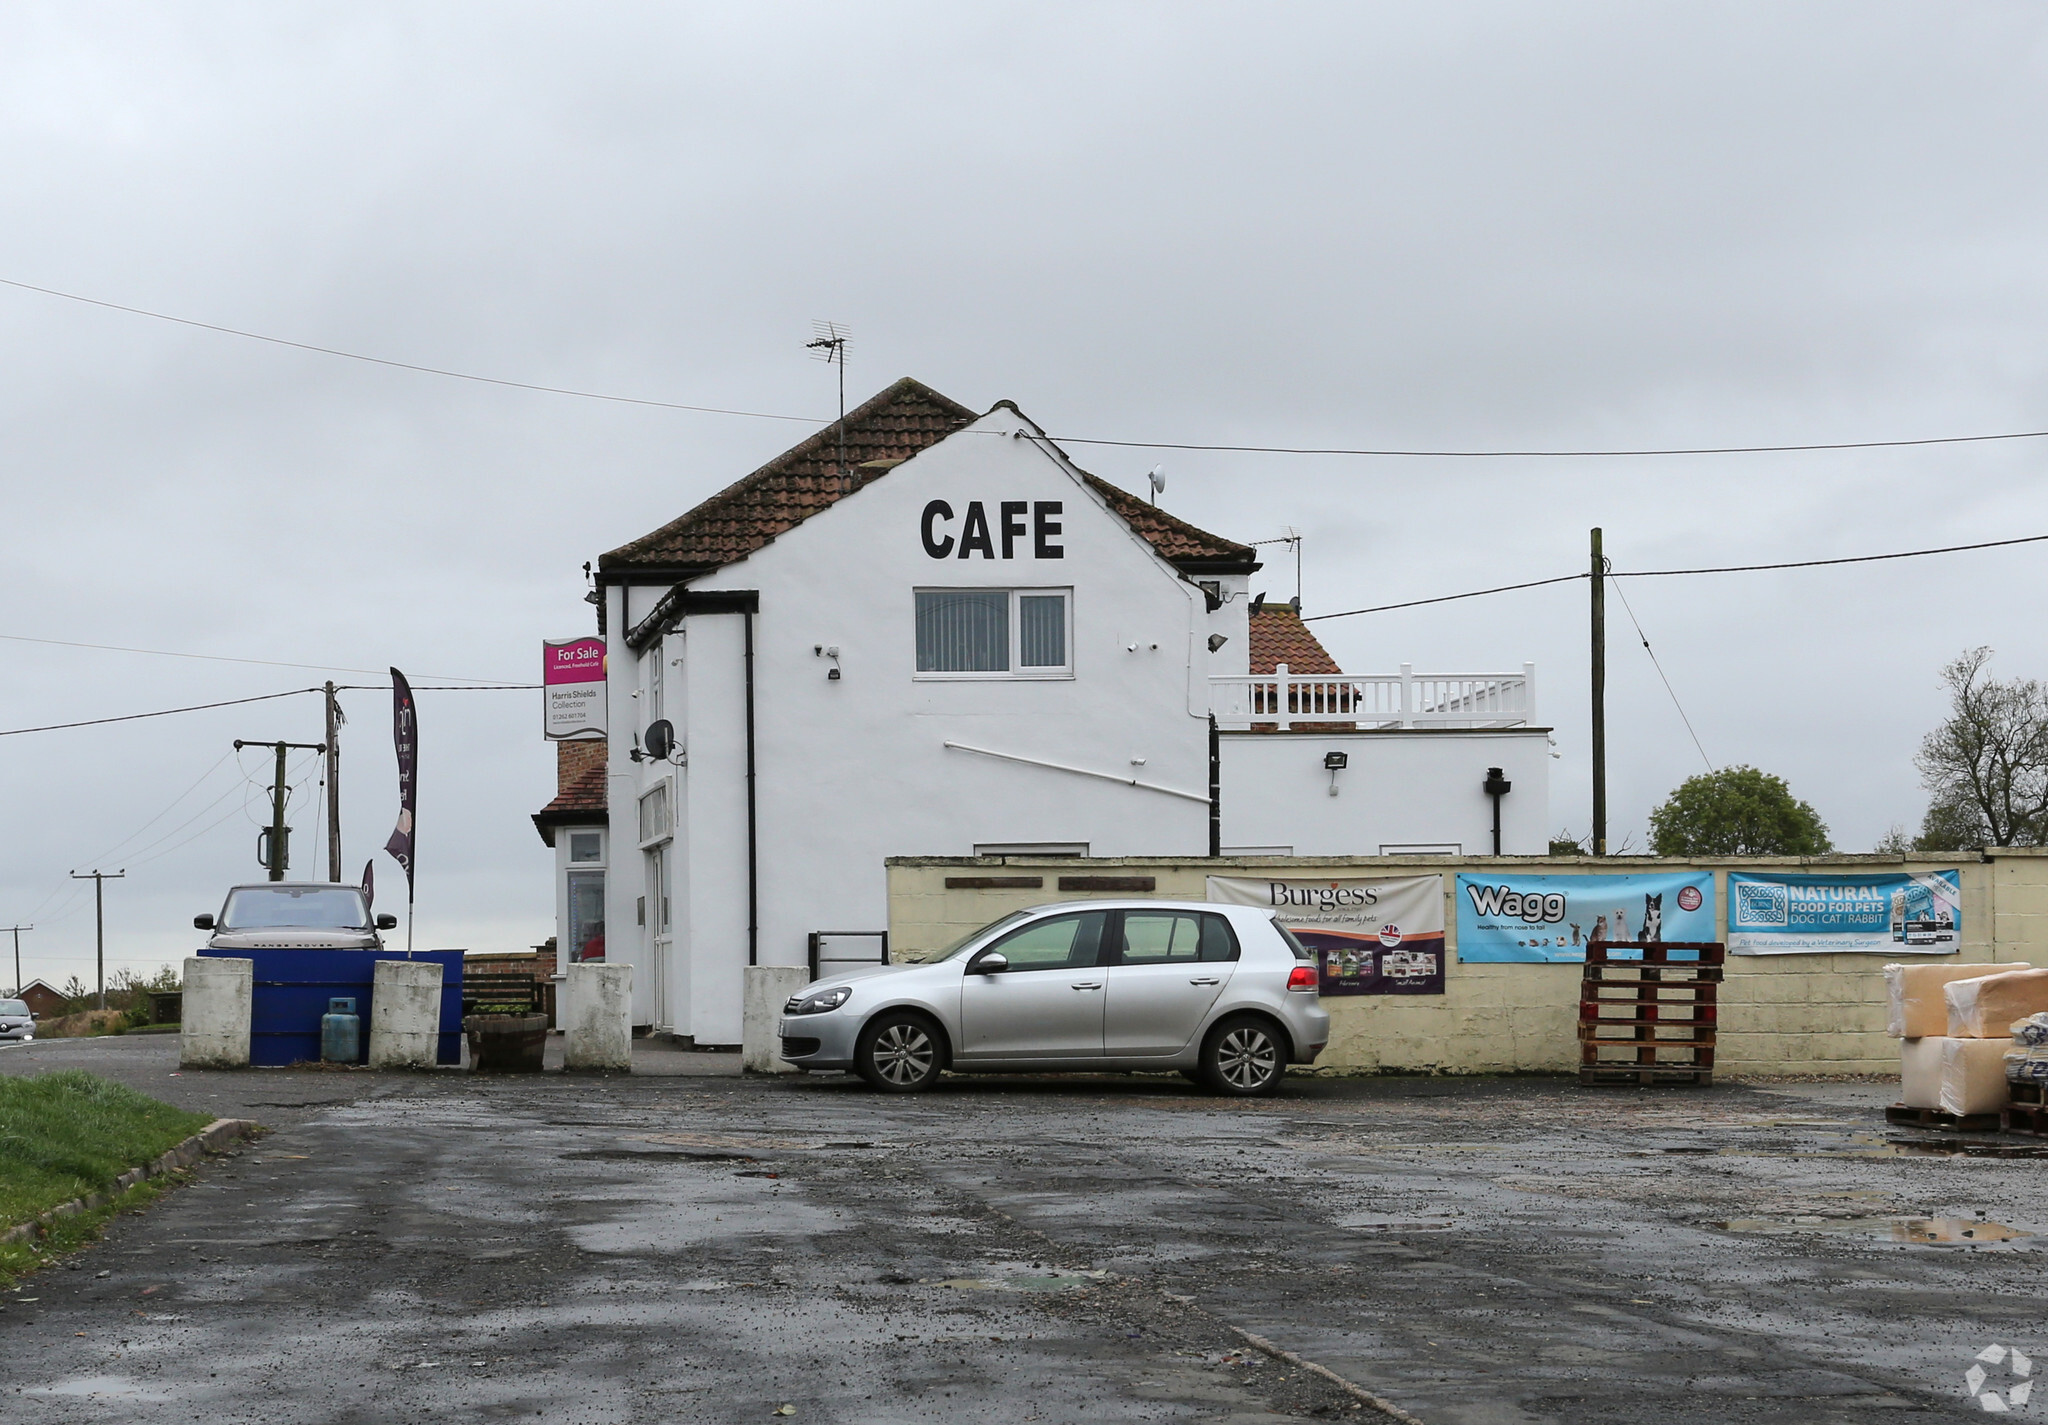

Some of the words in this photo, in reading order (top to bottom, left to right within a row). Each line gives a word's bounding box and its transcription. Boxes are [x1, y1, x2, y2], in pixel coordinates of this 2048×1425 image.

[920, 499, 1064, 559] CAFE
[558, 649, 575, 661] For
[576, 646, 599, 660] Sale
[552, 691, 572, 700] Harris
[572, 690, 597, 699] Shields
[552, 700, 586, 710] Collection
[1269, 882, 1378, 912] Burgess
[1790, 886, 1884, 901] NATURAL
[1466, 884, 1566, 923] Wagg
[1791, 902, 1826, 912] FOOD
[1829, 902, 1853, 912] FOR
[1855, 902, 1884, 912] PETS
[1276, 914, 1306, 923] holesome
[1322, 915, 1333, 924] for
[1341, 914, 1363, 926] family
[1362, 915, 1378, 925] pets
[1791, 914, 1815, 924] DOG
[1821, 914, 1842, 924] CAT
[1848, 914, 1884, 924] RABBIT
[1769, 939, 1801, 947] developed
[1802, 939, 1810, 948] by
[1817, 939, 1853, 947] Veterinary
[1854, 938, 1881, 947] Surgeon
